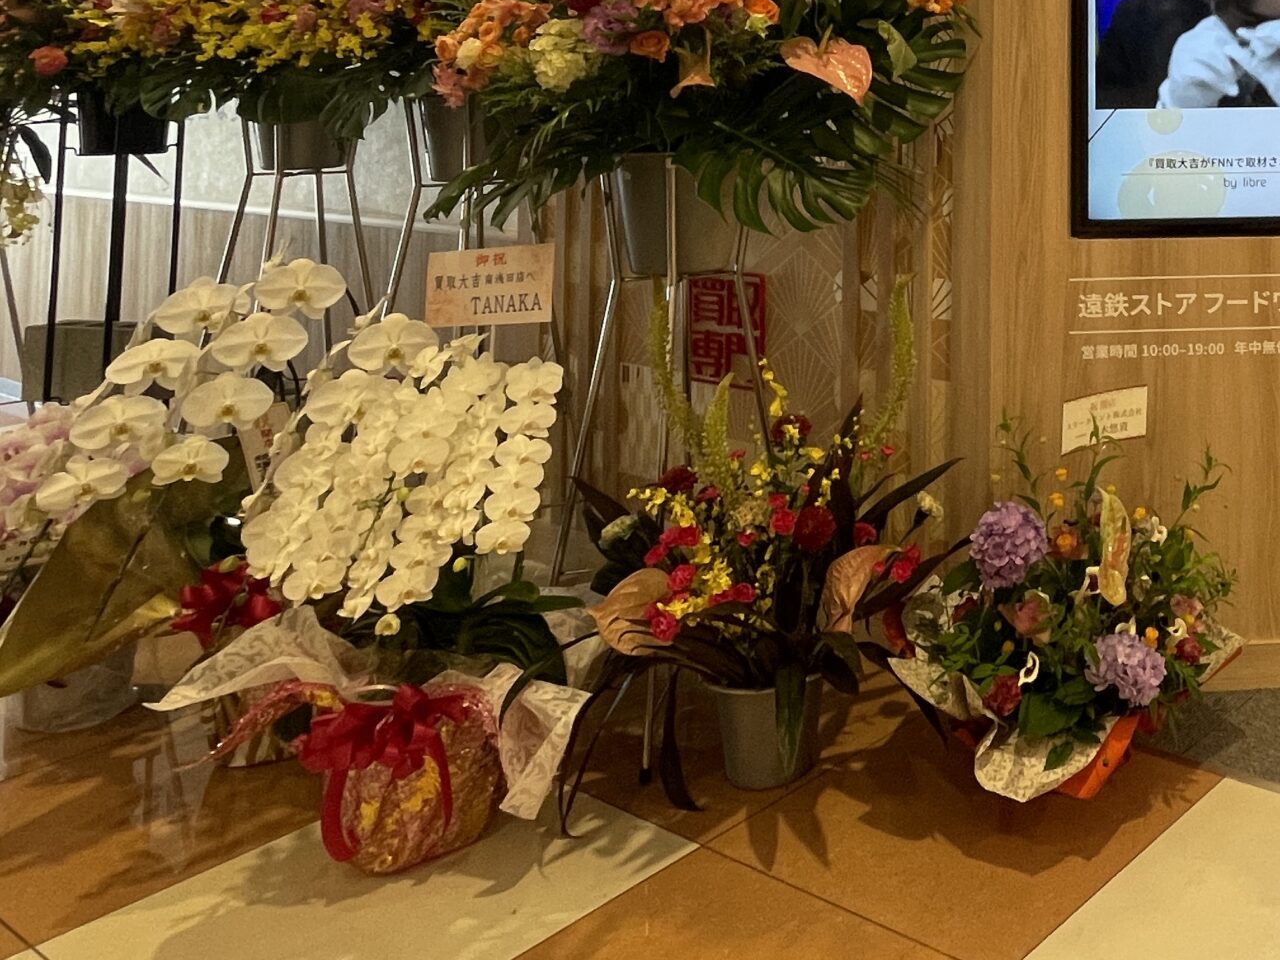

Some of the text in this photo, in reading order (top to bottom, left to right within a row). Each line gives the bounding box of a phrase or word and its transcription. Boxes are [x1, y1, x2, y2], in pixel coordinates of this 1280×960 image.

[1223, 176, 1267, 189] by libre
[475, 252, 507, 267] 御祝
[434, 273, 481, 291] 買取大吉
[470, 292, 543, 315] TANAKA
[1081, 345, 1137, 360] 営業時間
[1141, 343, 1225, 358] 10:00-19:00
